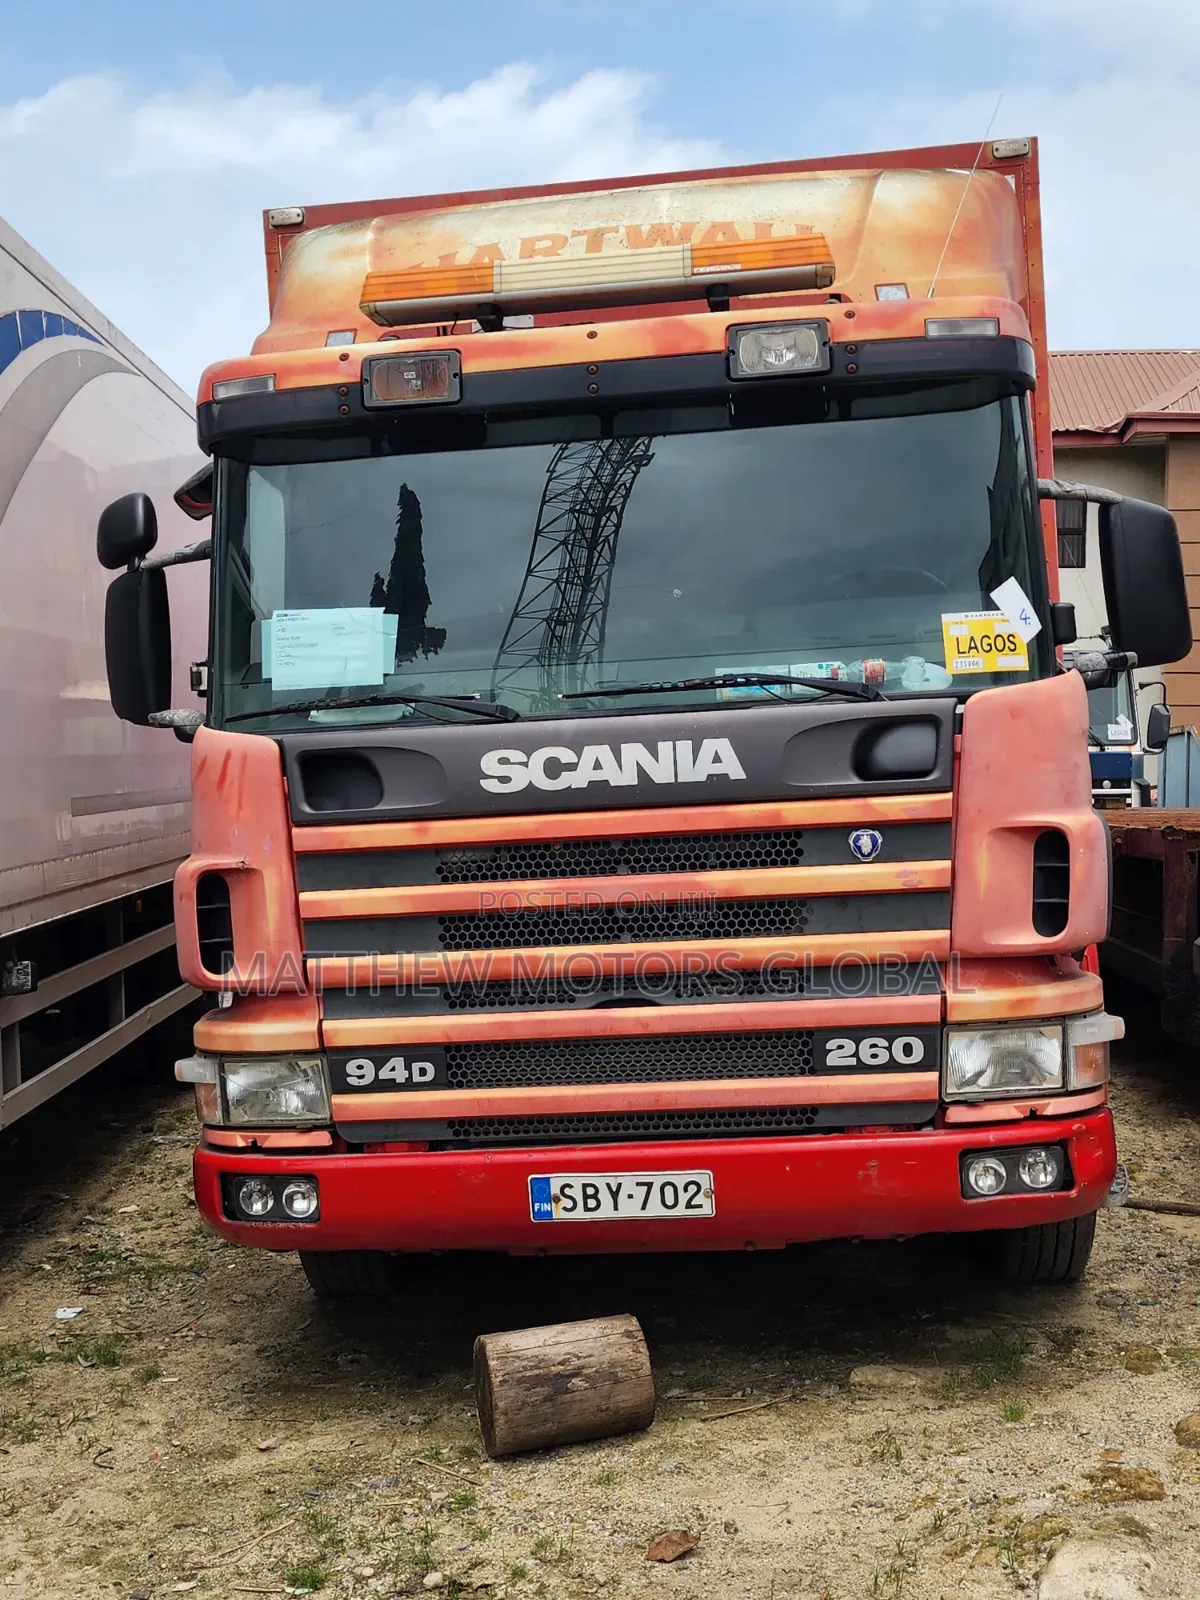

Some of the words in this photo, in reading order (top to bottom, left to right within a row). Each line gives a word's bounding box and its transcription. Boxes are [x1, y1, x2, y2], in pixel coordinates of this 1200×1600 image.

[955, 633, 1017, 655] LAGOS
[479, 737, 747, 794] SCANIA
[825, 1036, 925, 1067] 260
[345, 1057, 435, 1086] 94D
[534, 1202, 551, 1213] FIN
[559, 1180, 704, 1213] SBY-702
